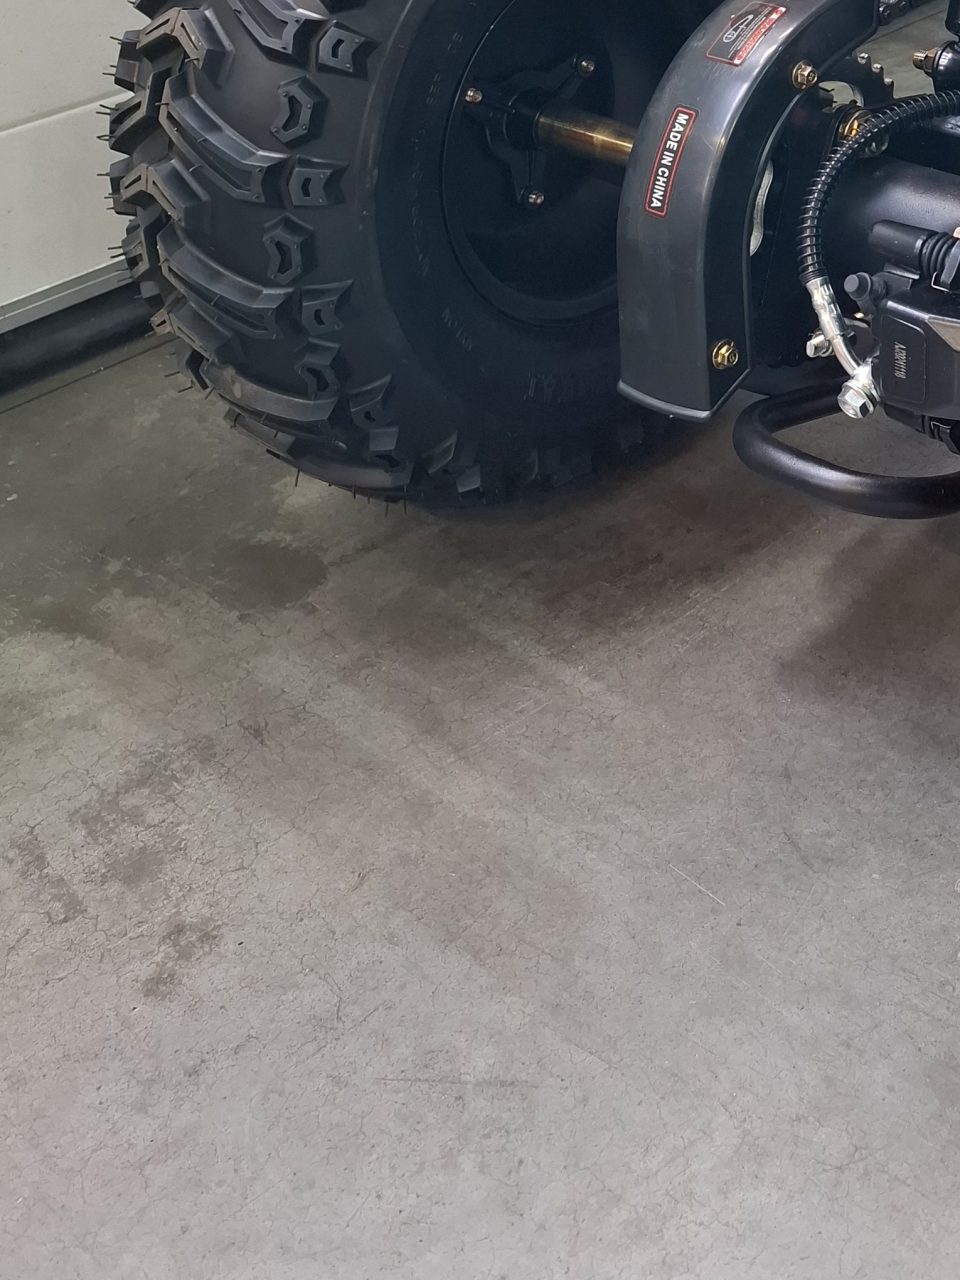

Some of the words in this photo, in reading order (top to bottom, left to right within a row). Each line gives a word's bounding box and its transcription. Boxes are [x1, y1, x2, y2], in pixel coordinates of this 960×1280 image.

[666, 113, 689, 151] MADE
[660, 151, 675, 166] IN
[650, 167, 669, 208] CHINA
